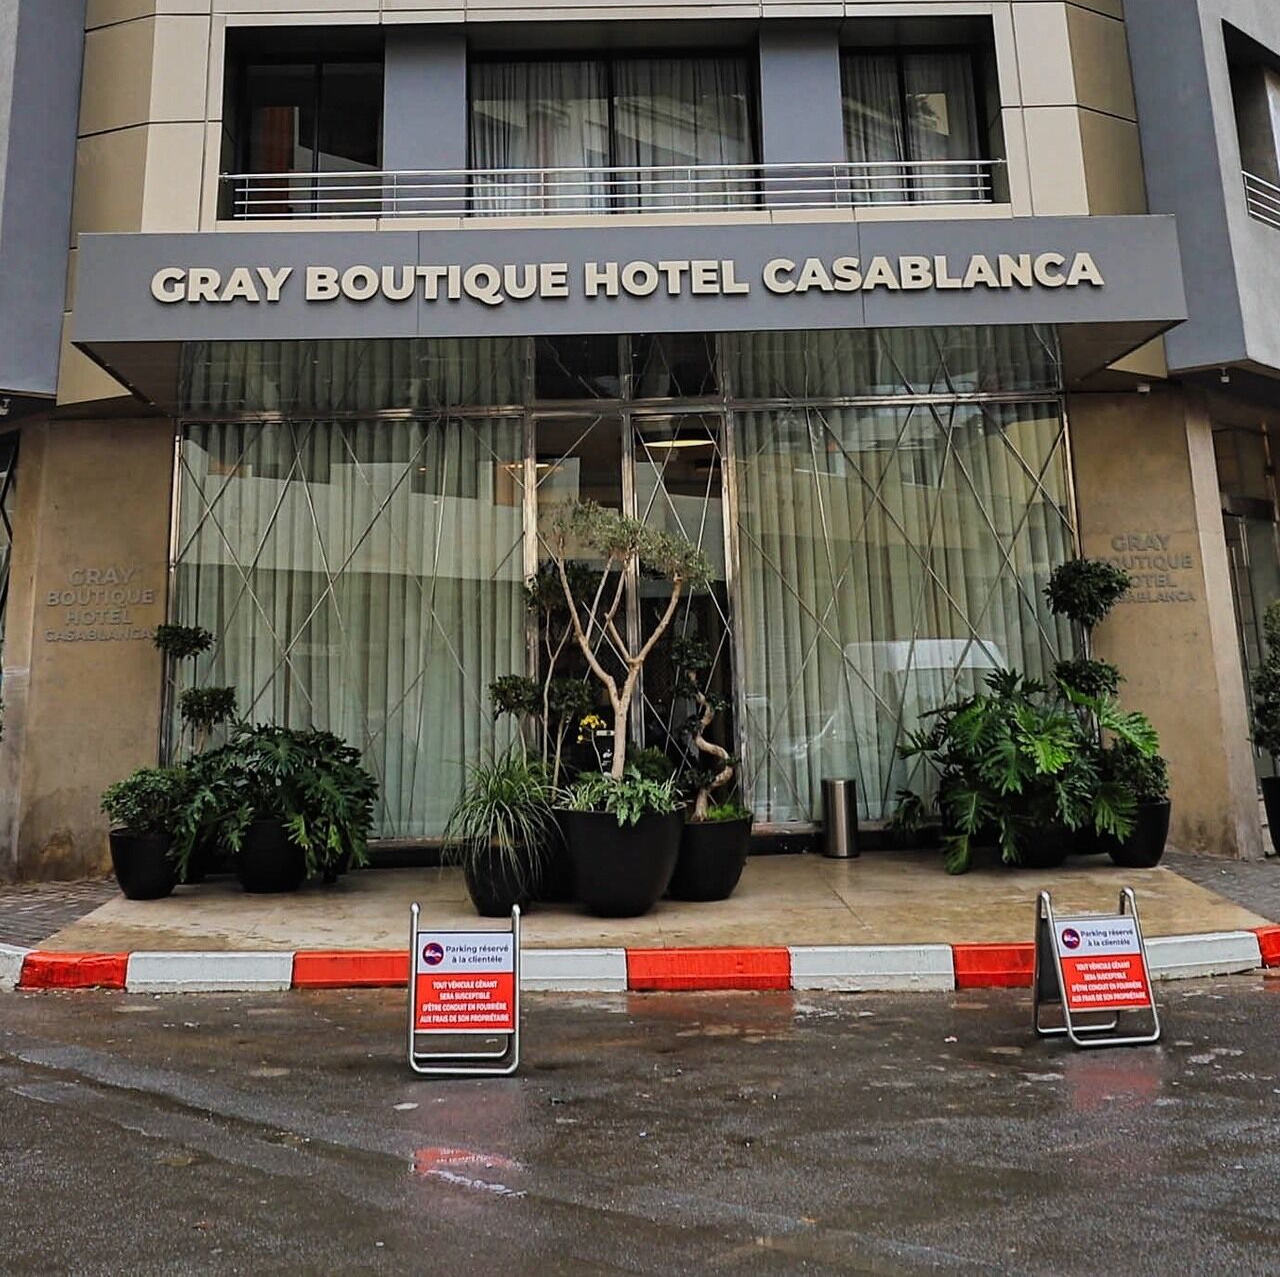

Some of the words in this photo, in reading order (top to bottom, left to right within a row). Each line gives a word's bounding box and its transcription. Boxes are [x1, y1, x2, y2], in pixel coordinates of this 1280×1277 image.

[151, 267, 293, 303] GRAY
[305, 263, 570, 305] BOUTIQUE
[584, 260, 750, 297] HOTEL
[763, 252, 1105, 292] CASABLANCA
[1110, 533, 1170, 552] GRAY
[69, 567, 136, 587] GRAY
[46, 588, 155, 609] BOUTIQUE
[65, 609, 134, 626] HOTEL
[43, 626, 156, 642] CASABLANCA
[445, 944, 477, 953] Parking
[479, 944, 509, 952] réservé
